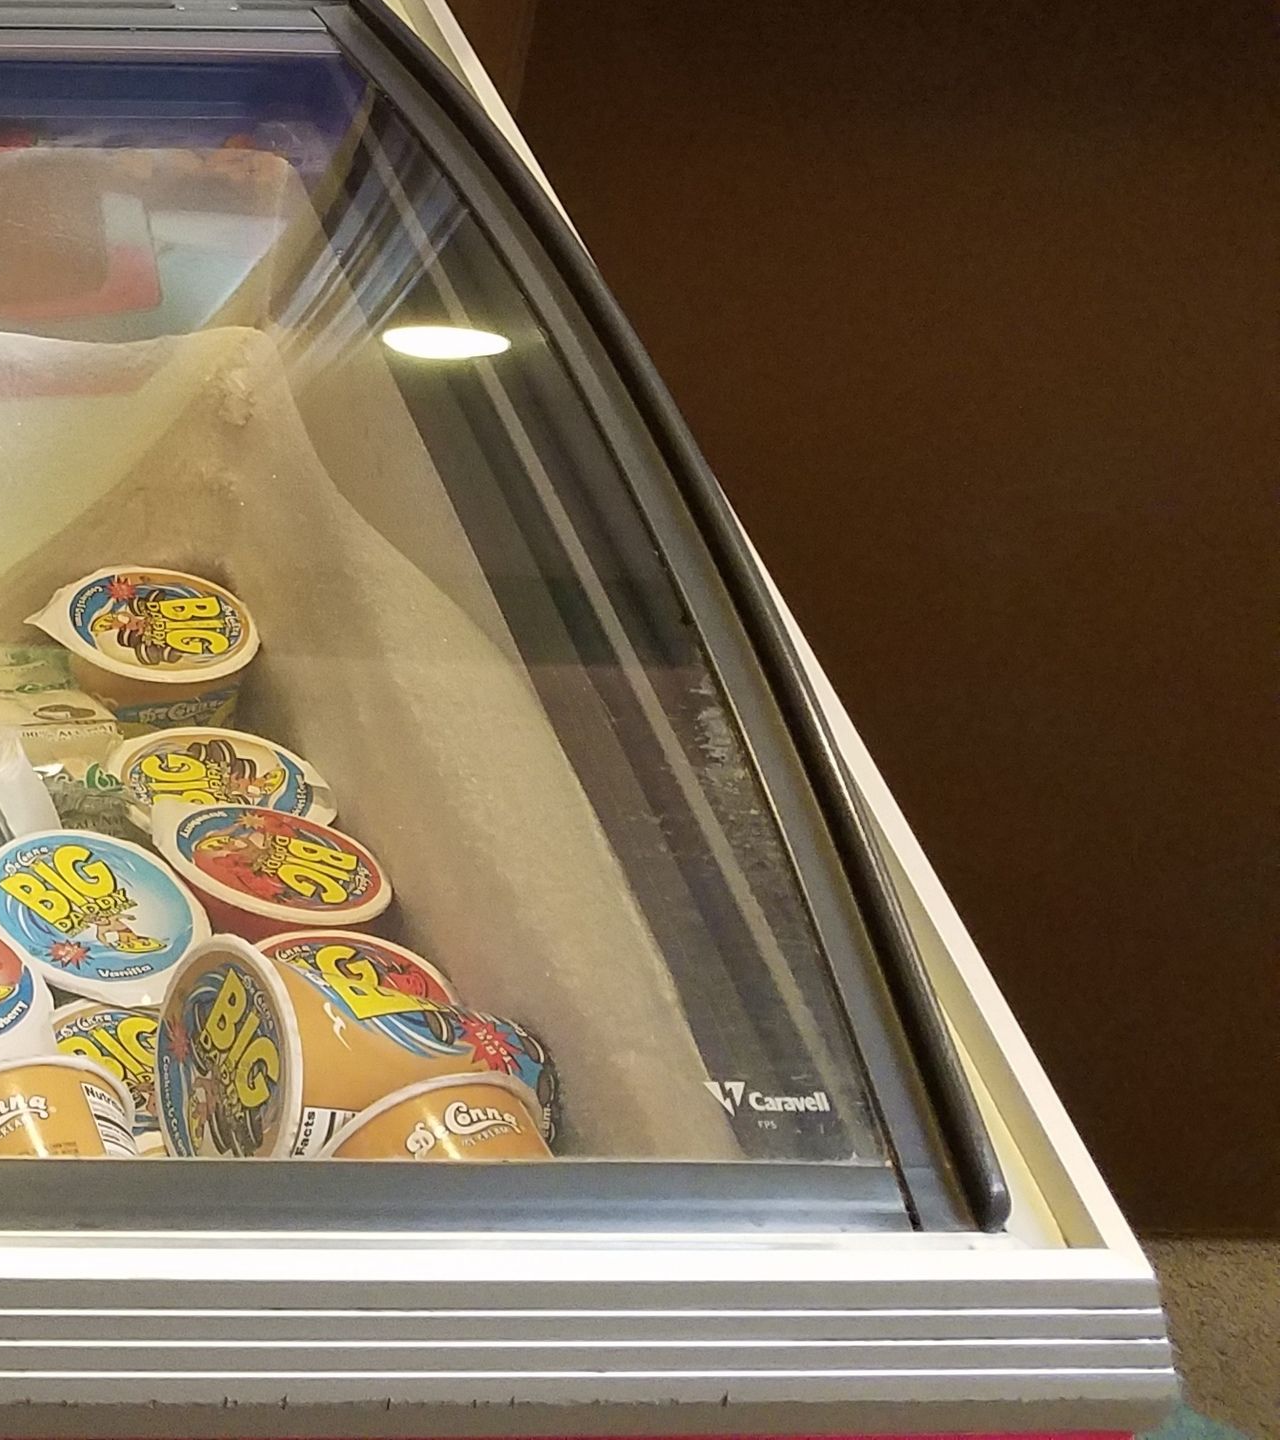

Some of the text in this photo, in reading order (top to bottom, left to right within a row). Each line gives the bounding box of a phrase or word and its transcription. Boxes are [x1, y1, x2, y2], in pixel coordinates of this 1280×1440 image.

[158, 596, 230, 655] BIG
[277, 838, 359, 905] BIG
[53, 887, 128, 936] DADDY
[96, 963, 154, 979] Vanilla
[205, 967, 281, 1108] BIG
[748, 1090, 831, 1113] Caravell
[294, 1109, 316, 1157] Facts
